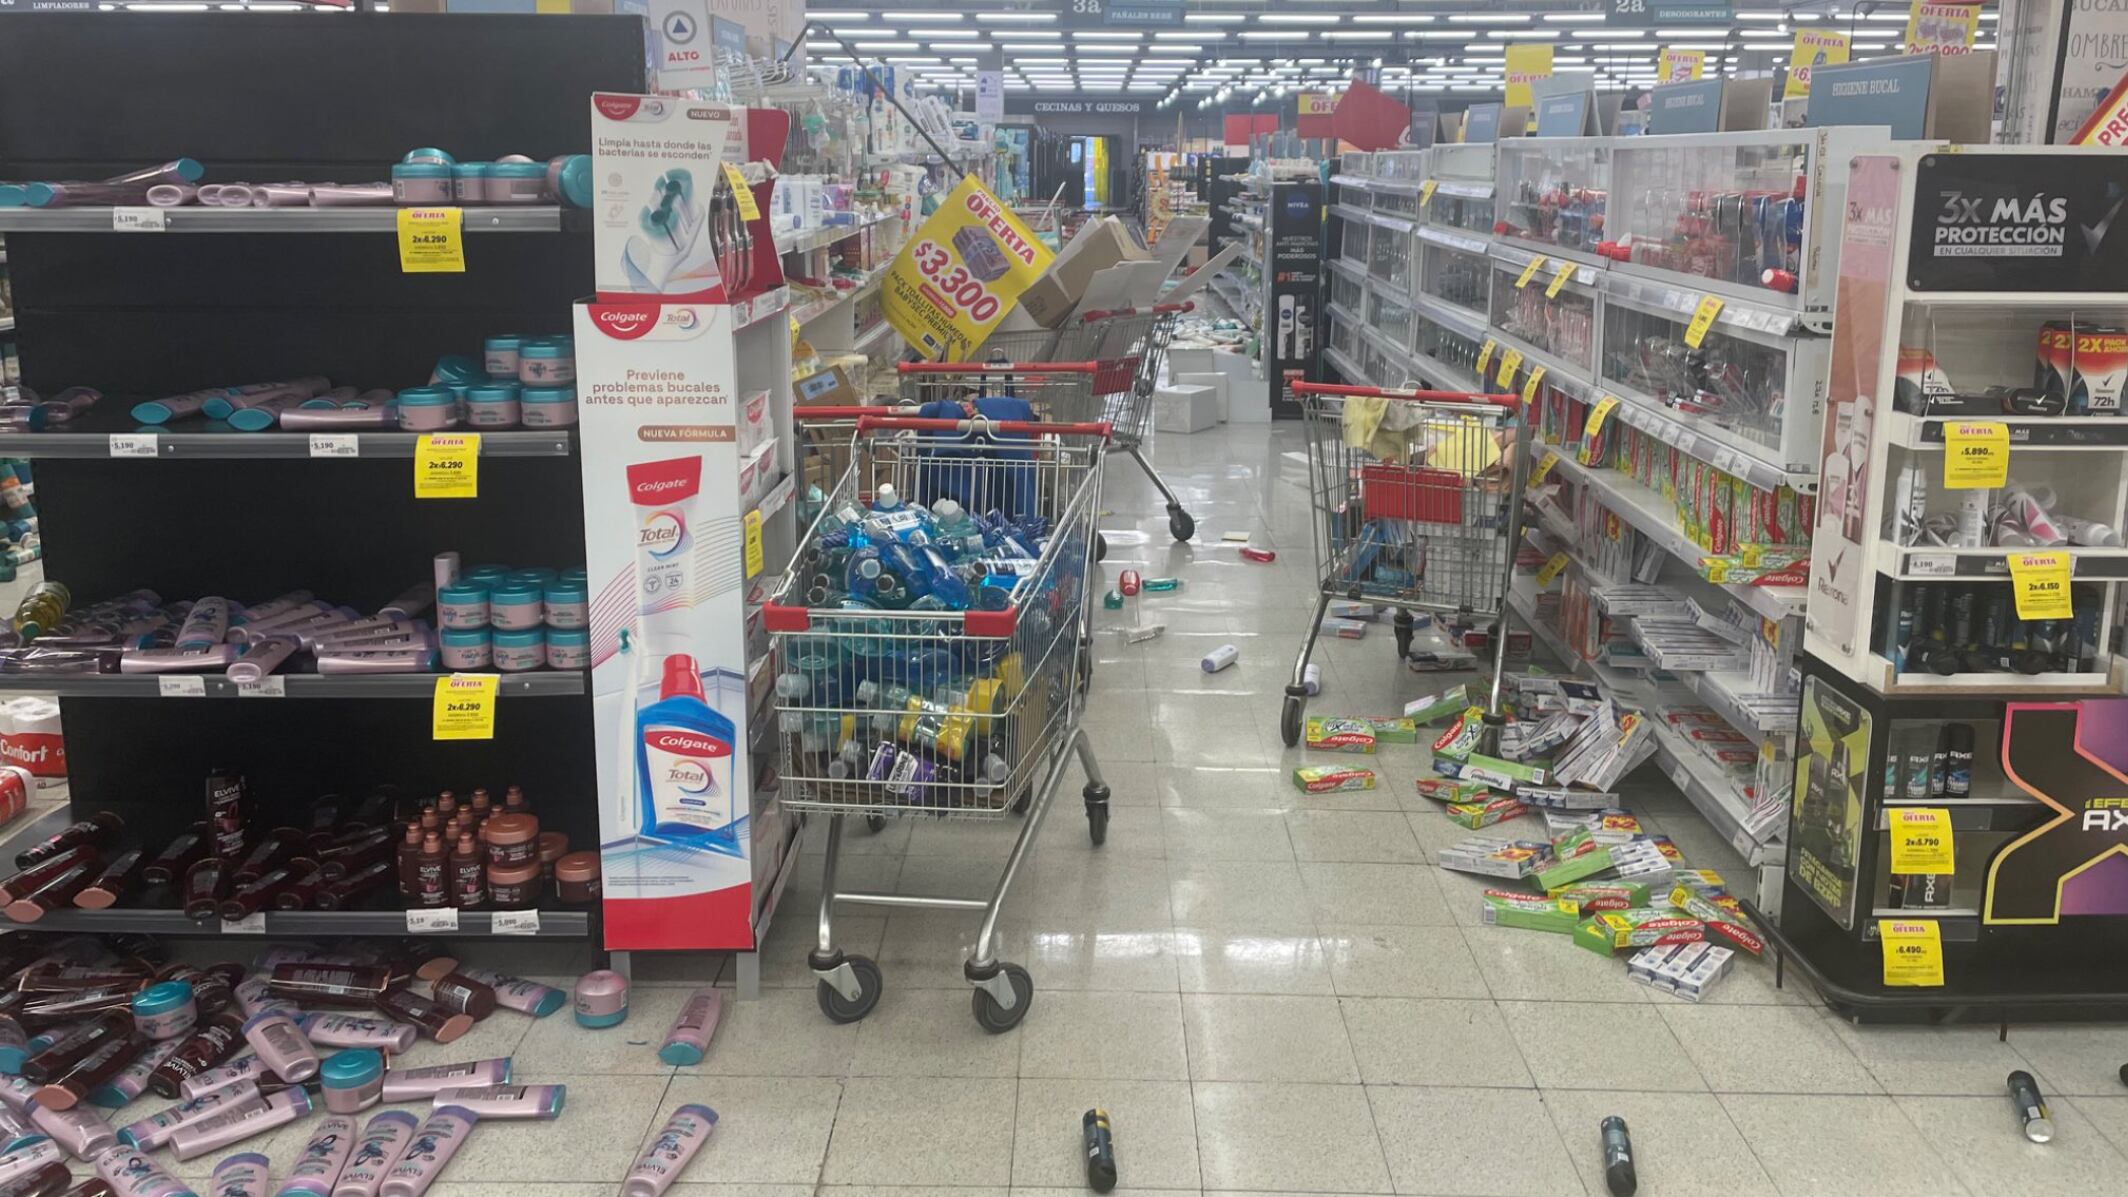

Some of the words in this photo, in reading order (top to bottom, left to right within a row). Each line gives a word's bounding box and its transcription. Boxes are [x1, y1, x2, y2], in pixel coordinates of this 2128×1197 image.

[1659, 10, 1727, 18] DESODORANTES
[1920, 6, 1970, 19] OFERTA
[668, 51, 700, 62] ALTO
[1869, 78, 1900, 95] BUCAL
[1035, 103, 1082, 112] CECINAS
[1085, 103, 1093, 111] Y
[1096, 103, 1140, 112] QUESOS
[691, 110, 720, 118] NUEVO
[598, 138, 631, 148] Limpia
[633, 139, 661, 148] hasta
[664, 140, 696, 149] donde
[697, 141, 712, 150] las
[598, 148, 645, 157] bacterias
[648, 150, 659, 158] se
[1990, 193, 2068, 223] MÁS
[966, 193, 1036, 265] OFERTA
[1935, 225, 2066, 244] PROTECCIÓN
[1939, 246, 1953, 255] EN
[1954, 246, 2007, 255] CUALQUIER
[2009, 246, 2058, 255] SITUACIÓN
[913, 241, 999, 322] $3.300
[600, 312, 648, 323] Colgate
[626, 369, 685, 381] Previene
[593, 382, 663, 394] problemas
[667, 382, 720, 393] bucales
[585, 394, 624, 405] antes
[627, 394, 653, 407] que
[2094, 397, 2115, 407] 72h
[643, 430, 677, 438] NUEVA
[679, 428, 727, 438] FÓRMULA
[636, 478, 688, 493] Colgate
[639, 525, 677, 543] Total
[0, 738, 48, 763] Confort
[659, 736, 718, 753] Colgate
[1950, 750, 1973, 760] AXE
[668, 769, 705, 783] Total
[1903, 814, 1936, 822] OFERTA
[1595, 899, 1630, 909] Colgate
[1648, 919, 1699, 928] Colgate
[1666, 931, 1703, 941] Colgate
[1721, 922, 1762, 951] Colgate
